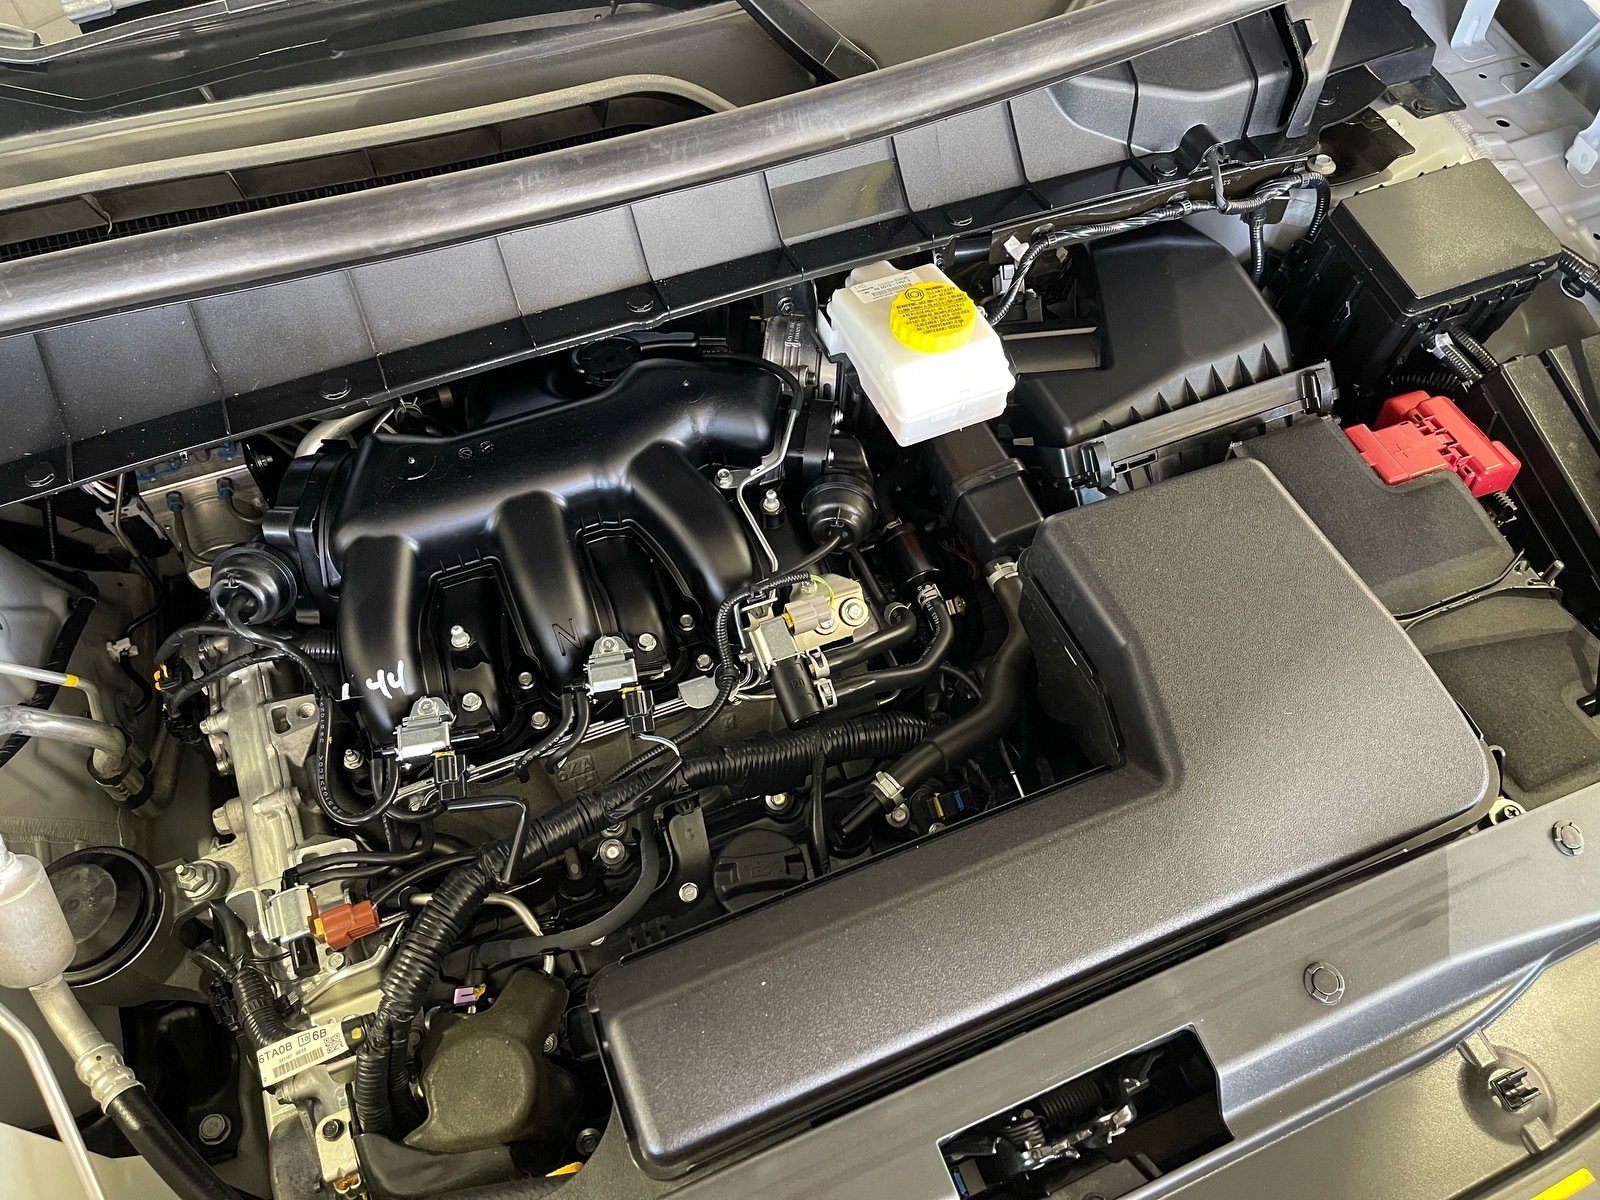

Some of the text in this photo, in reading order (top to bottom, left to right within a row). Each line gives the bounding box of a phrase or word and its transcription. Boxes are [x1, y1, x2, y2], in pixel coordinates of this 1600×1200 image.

[258, 1028, 327, 1064] 6TA0B 10 6B
